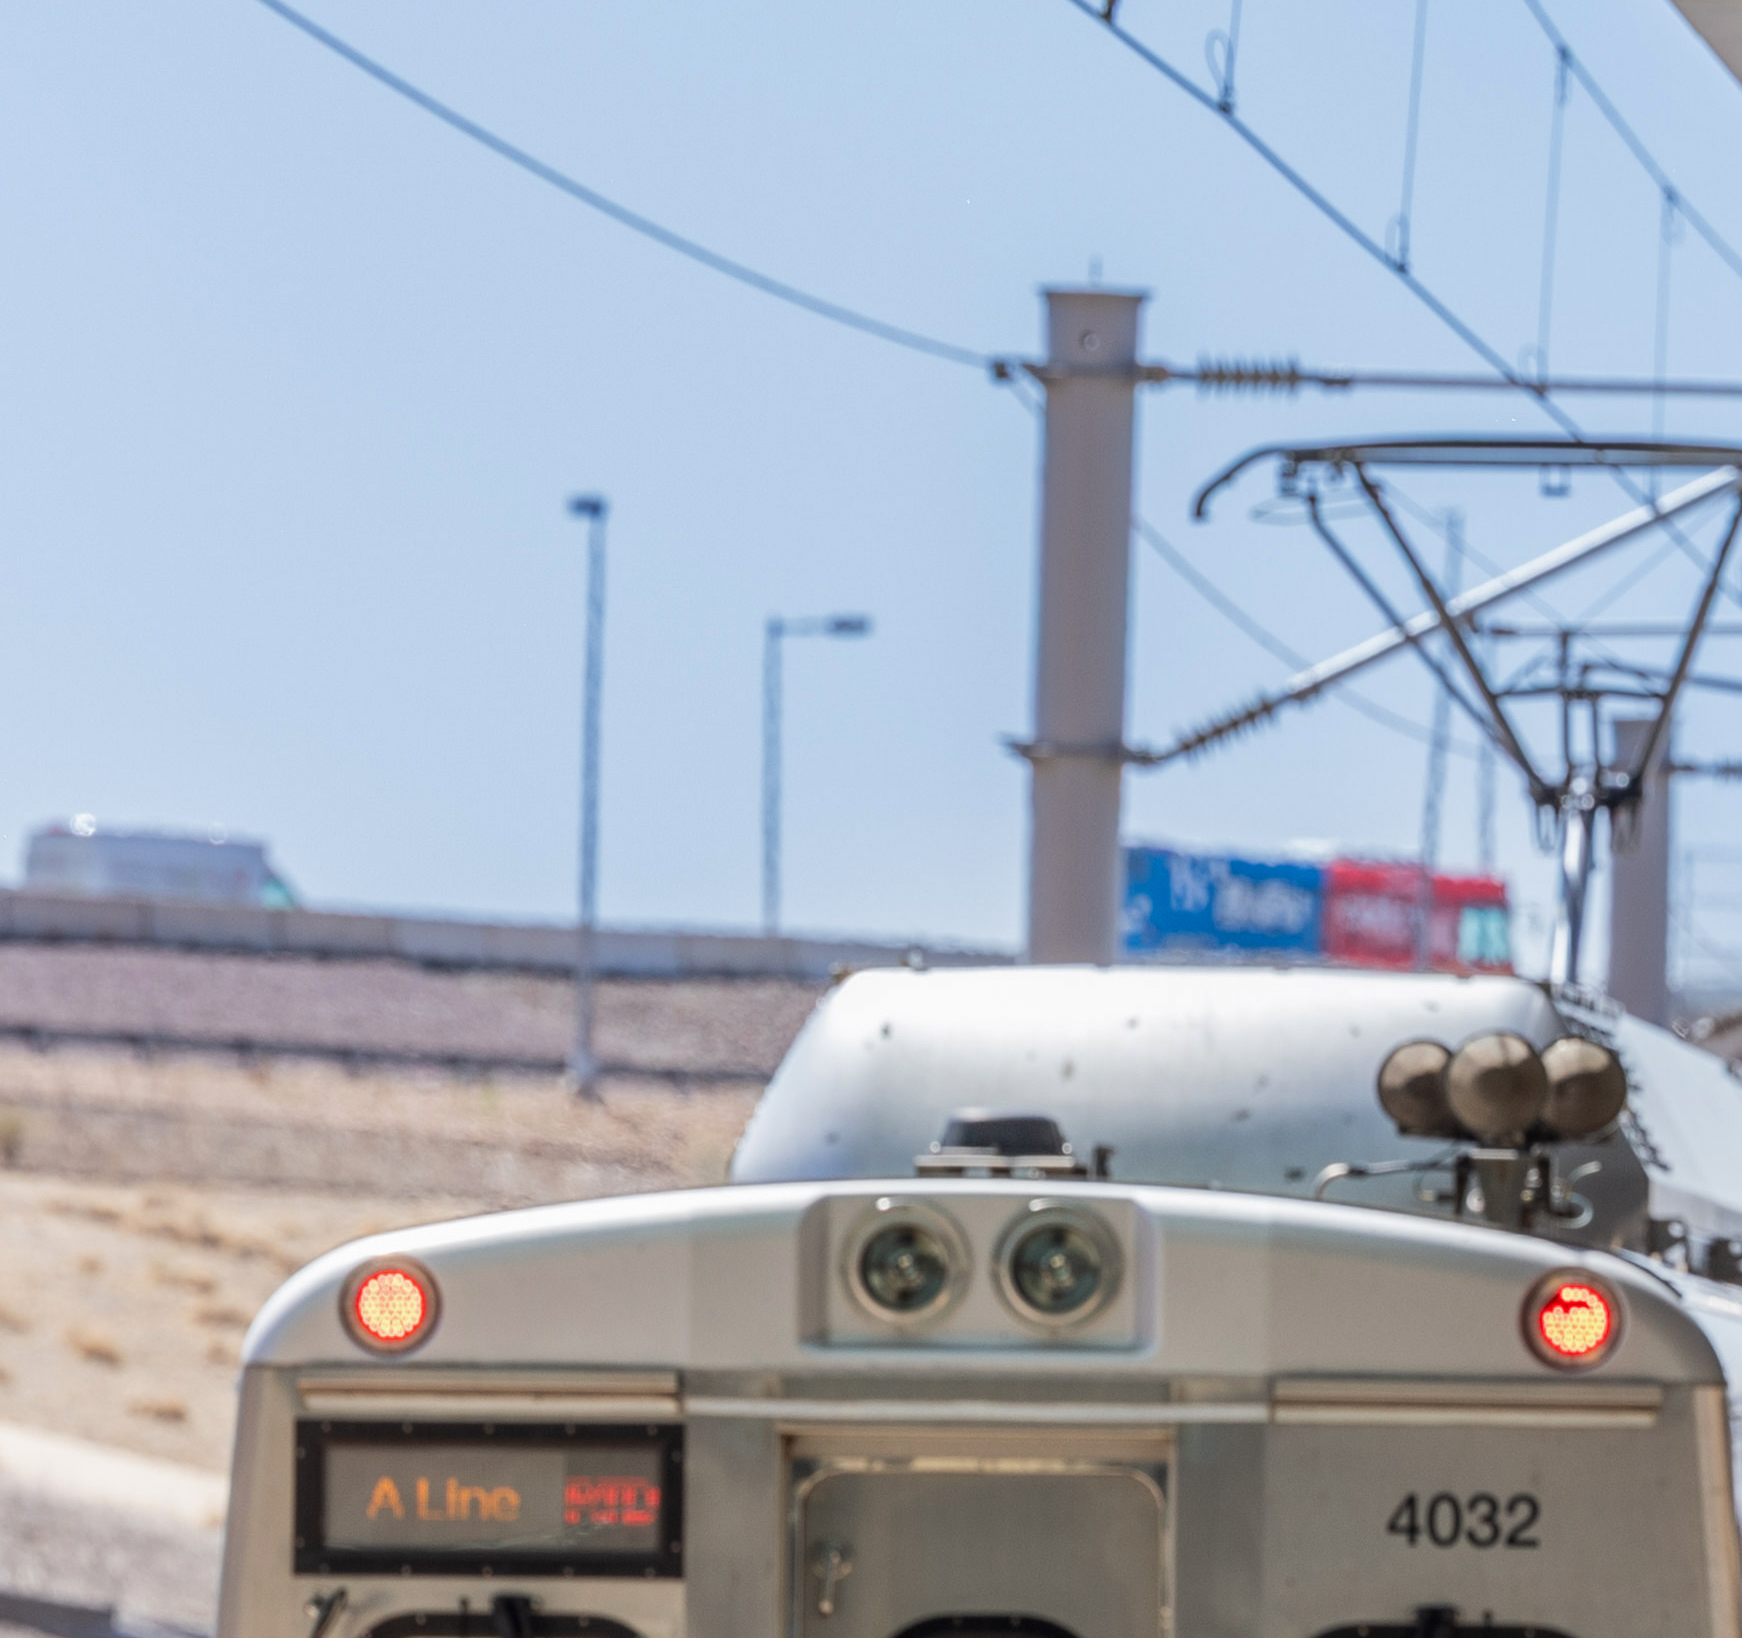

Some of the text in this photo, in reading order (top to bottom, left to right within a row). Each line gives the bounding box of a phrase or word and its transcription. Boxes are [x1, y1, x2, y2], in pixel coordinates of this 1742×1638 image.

[366, 1475, 405, 1520] A
[415, 1476, 522, 1522] Line
[1386, 1491, 1541, 1549] 4032
